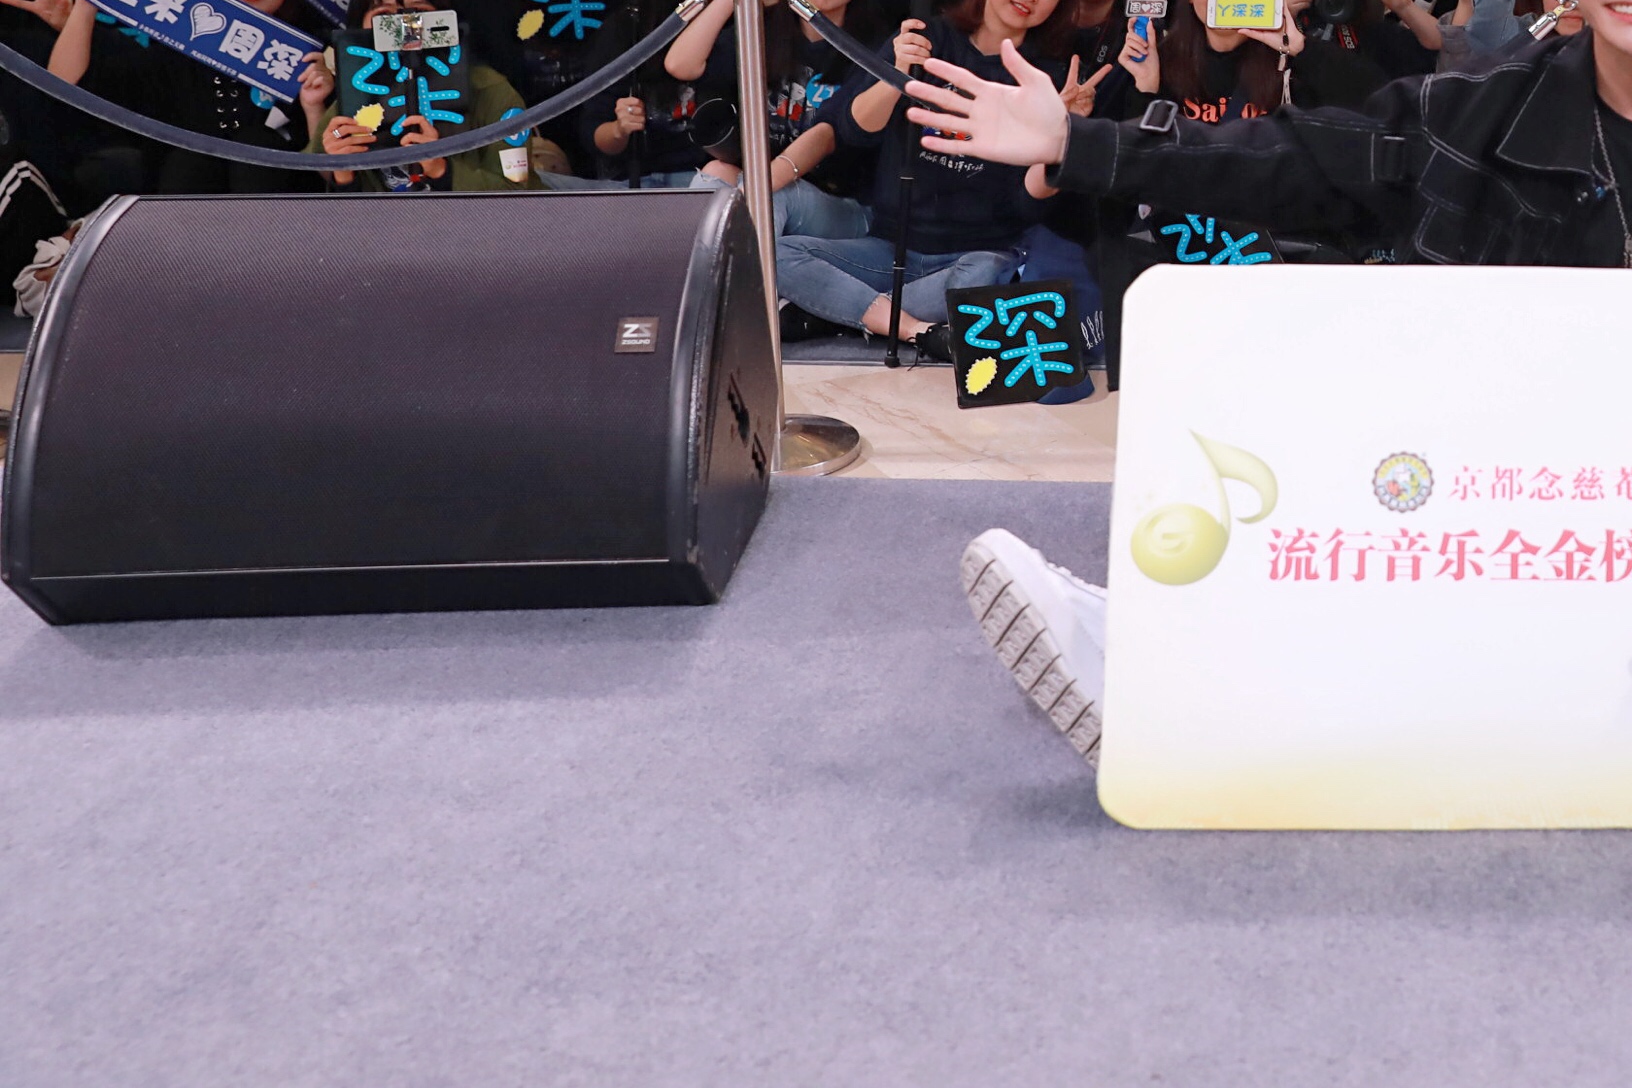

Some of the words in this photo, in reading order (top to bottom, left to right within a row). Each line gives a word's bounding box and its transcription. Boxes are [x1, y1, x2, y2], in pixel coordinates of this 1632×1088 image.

[218, 18, 304, 83] 周深
[1096, 45, 1108, 62] EOS
[957, 291, 1075, 388] 深
